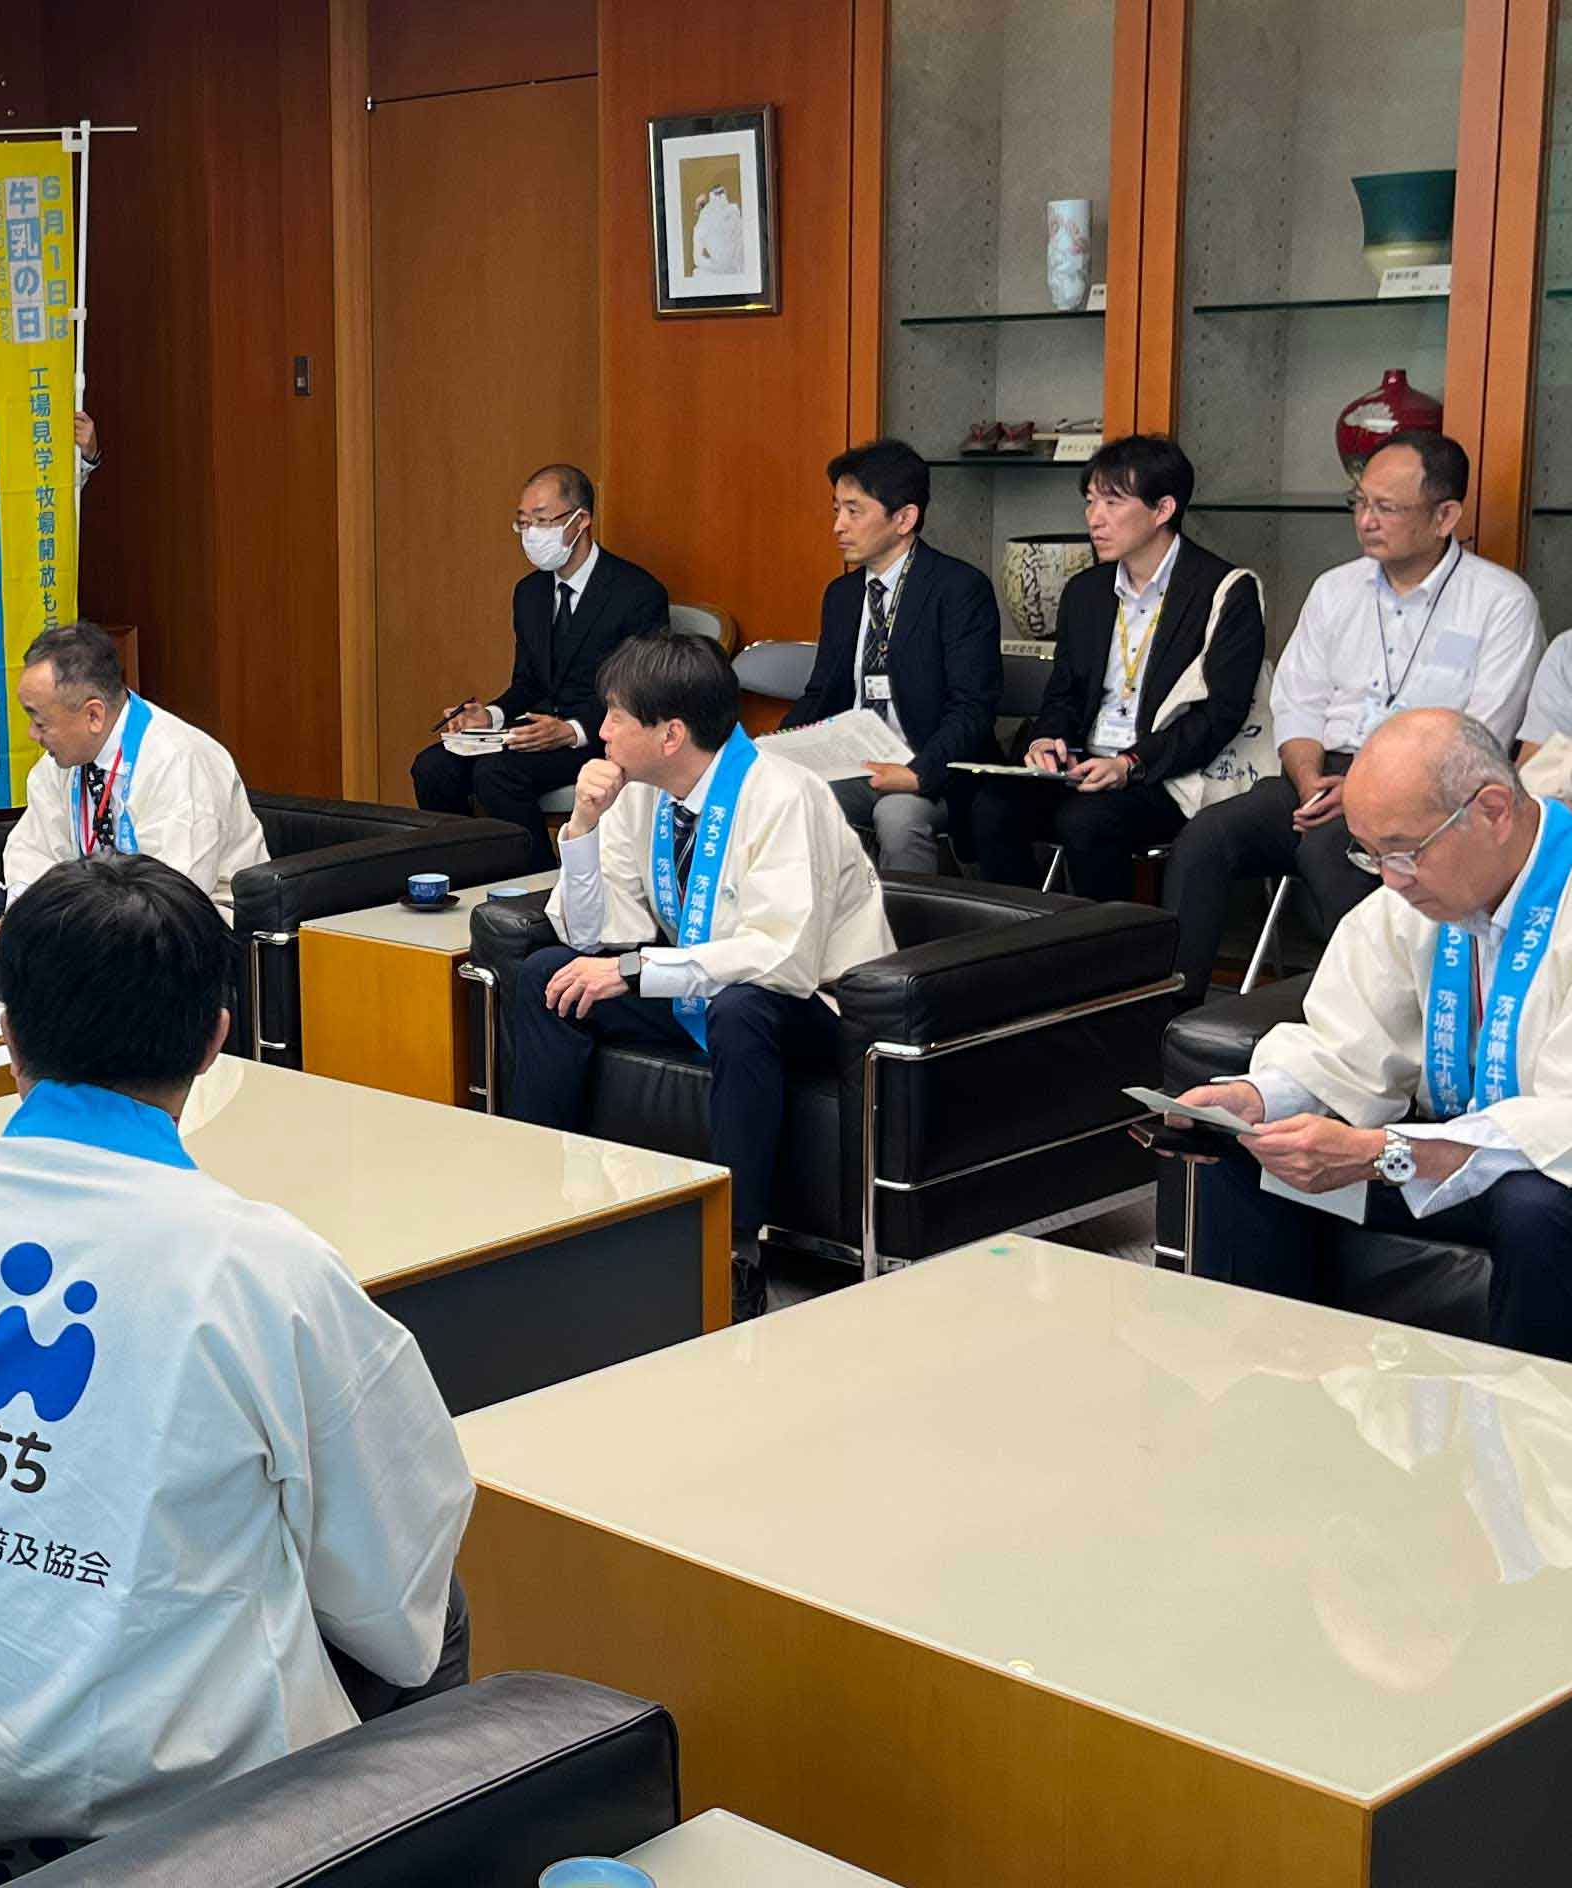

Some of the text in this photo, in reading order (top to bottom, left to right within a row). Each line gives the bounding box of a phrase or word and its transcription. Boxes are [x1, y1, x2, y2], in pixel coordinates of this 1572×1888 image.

[8, 180, 42, 341] 牛乳の日
[43, 175, 69, 340] 6月1日は
[684, 805, 726, 945] 茨ちち 茨城県牛
[1511, 906, 1554, 972] 茨ちち
